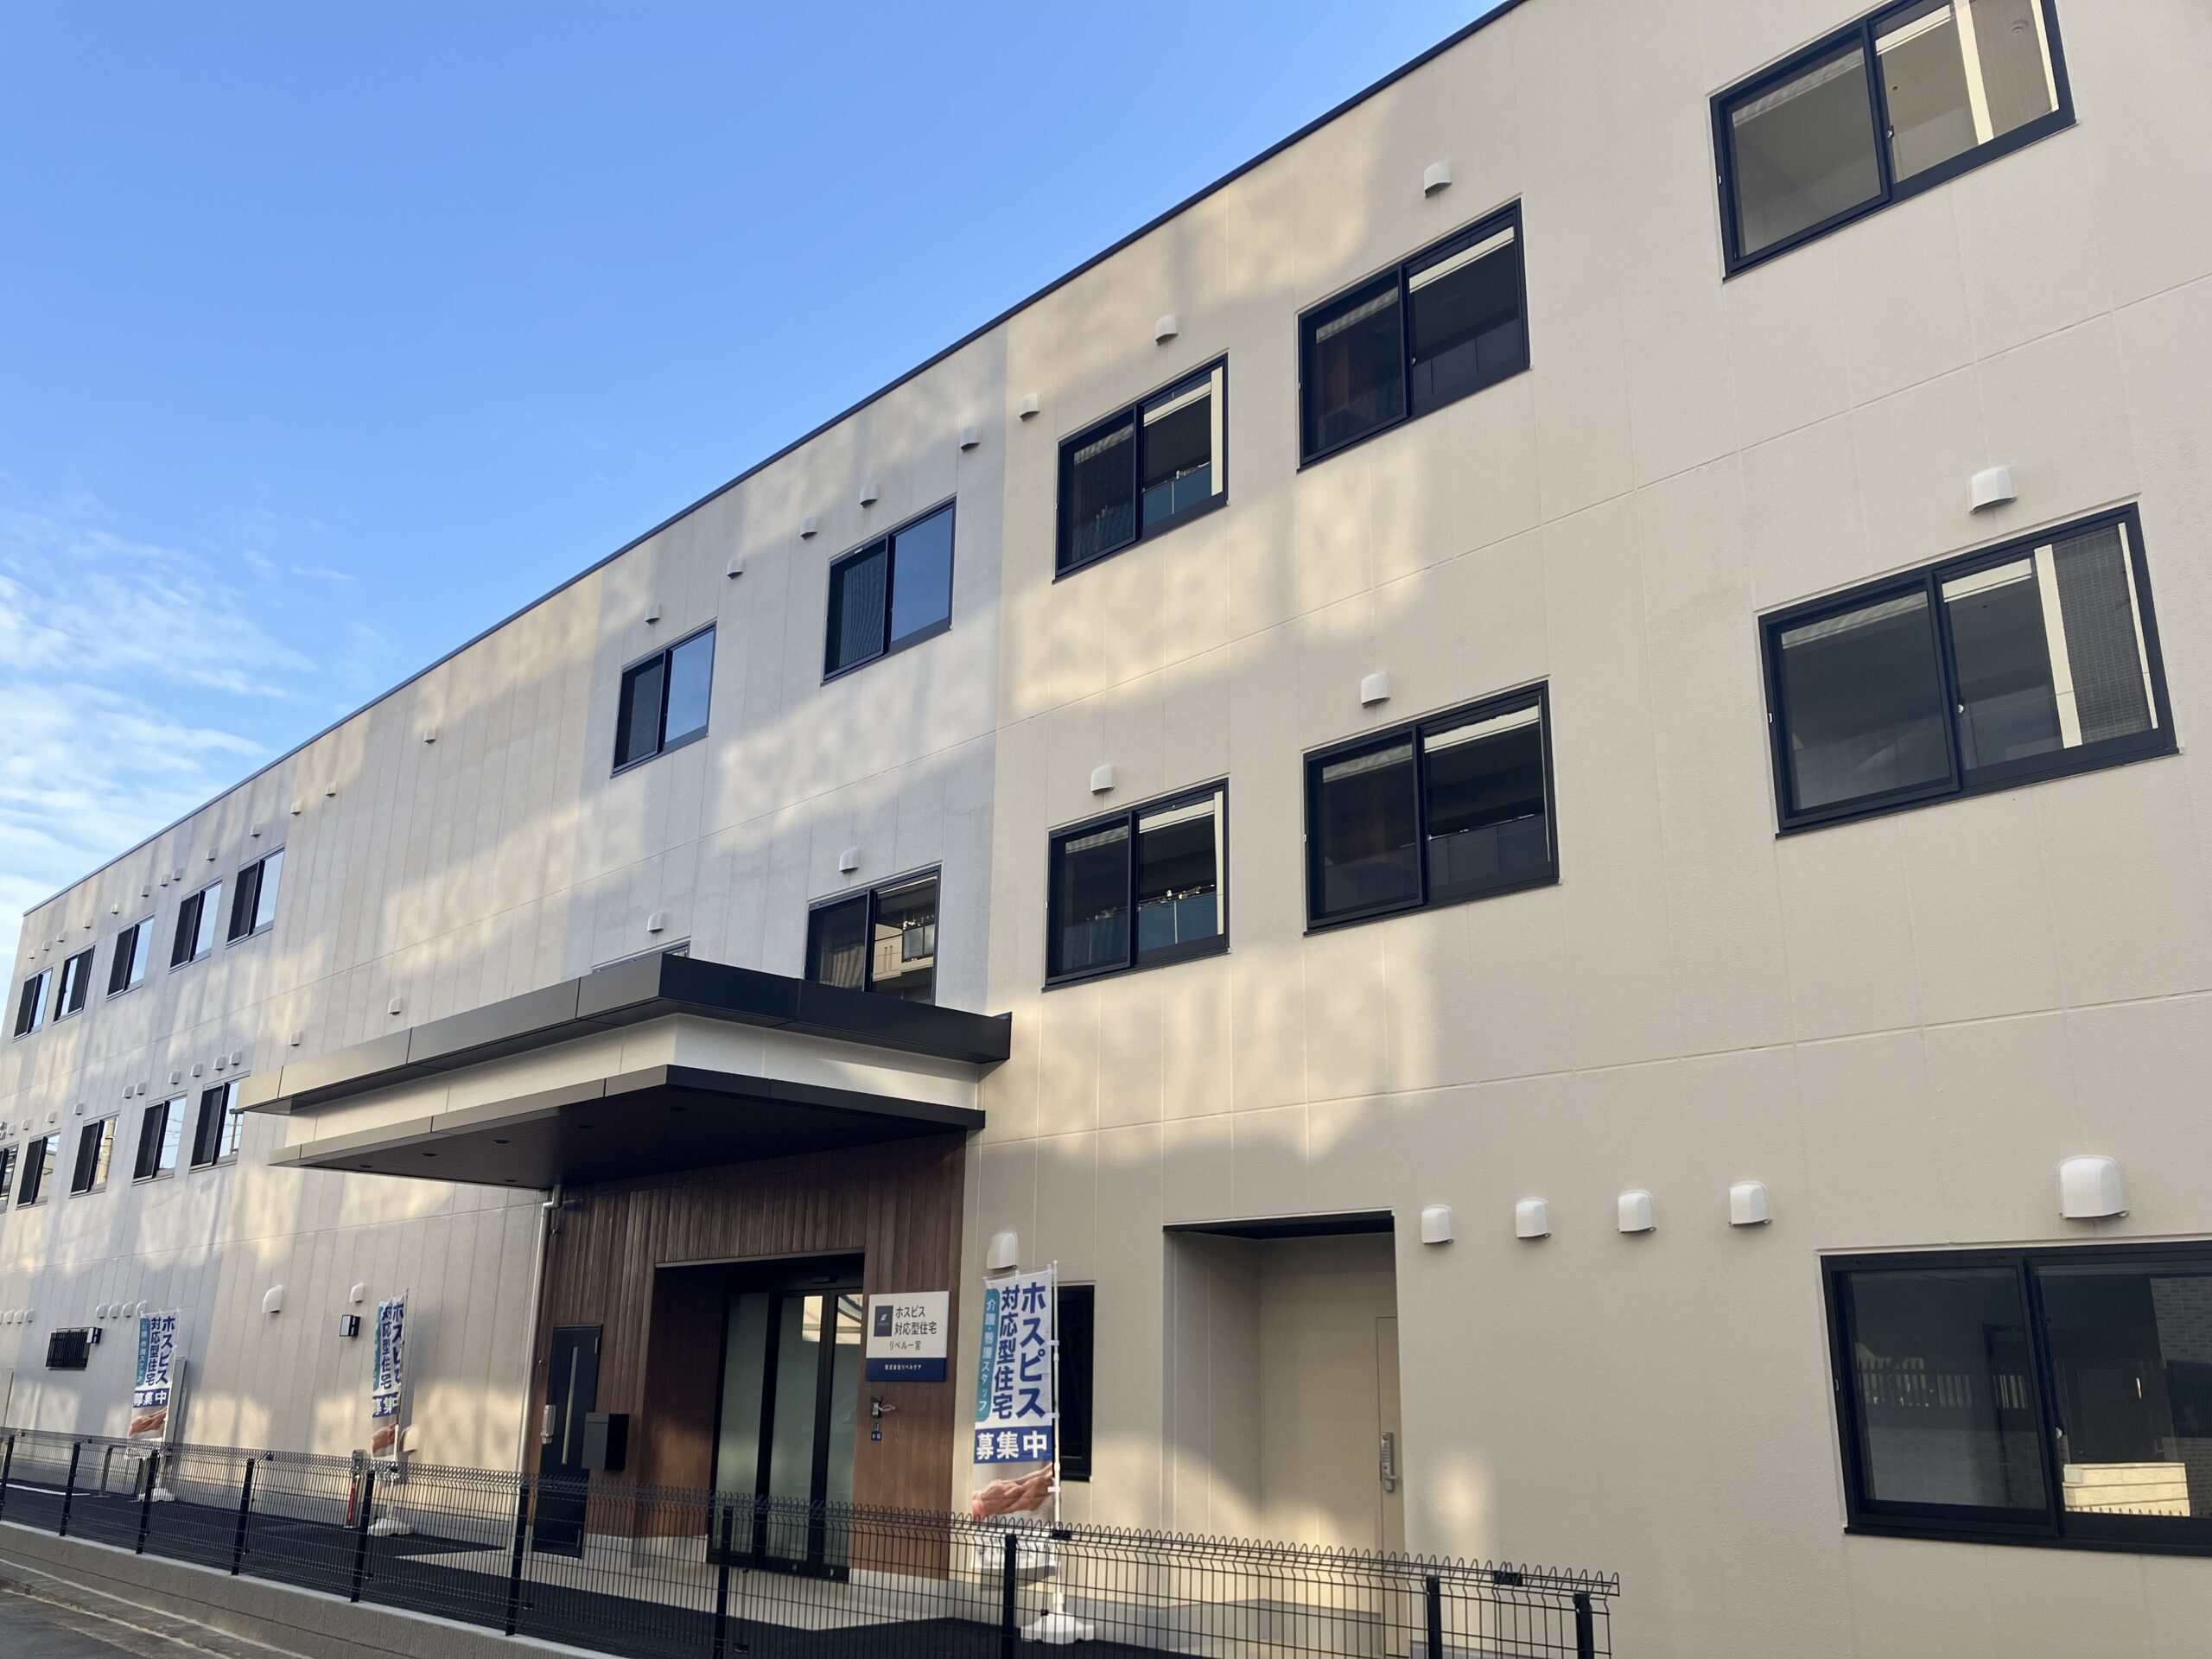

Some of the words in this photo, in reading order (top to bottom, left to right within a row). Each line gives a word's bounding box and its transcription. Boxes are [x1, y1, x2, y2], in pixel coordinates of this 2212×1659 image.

[894, 1321, 938, 1336] 対応型住宅
[895, 1305, 926, 1319] ホスピス
[146, 1317, 162, 1386] 対応型住宅
[156, 1316, 175, 1384] ホスピス
[992, 1285, 1020, 1420] 対応型住宅
[1015, 1281, 1046, 1419] ホスピス
[976, 1430, 1047, 1460] 募集中
